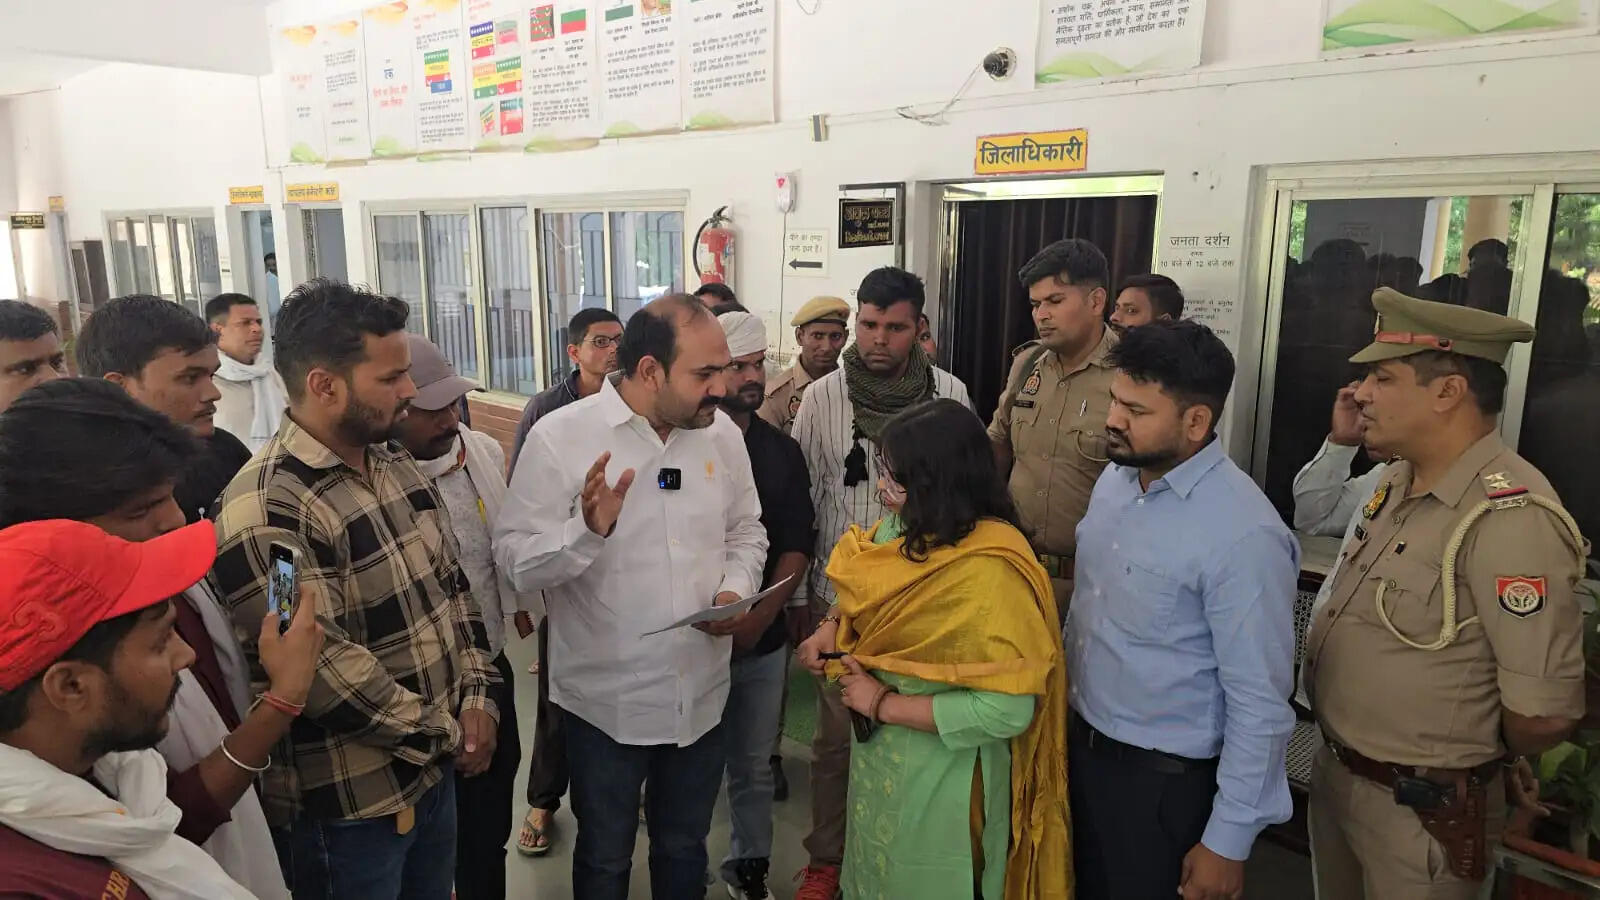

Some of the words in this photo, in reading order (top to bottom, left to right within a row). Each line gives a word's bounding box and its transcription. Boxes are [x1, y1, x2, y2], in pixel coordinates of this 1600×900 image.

[979, 135, 1083, 165] जिलाधिकारी
[1169, 236, 1200, 246] जनता
[1204, 232, 1230, 246] दर्शन
[1172, 258, 1182, 267] बजे
[1207, 258, 1219, 267] बजे
